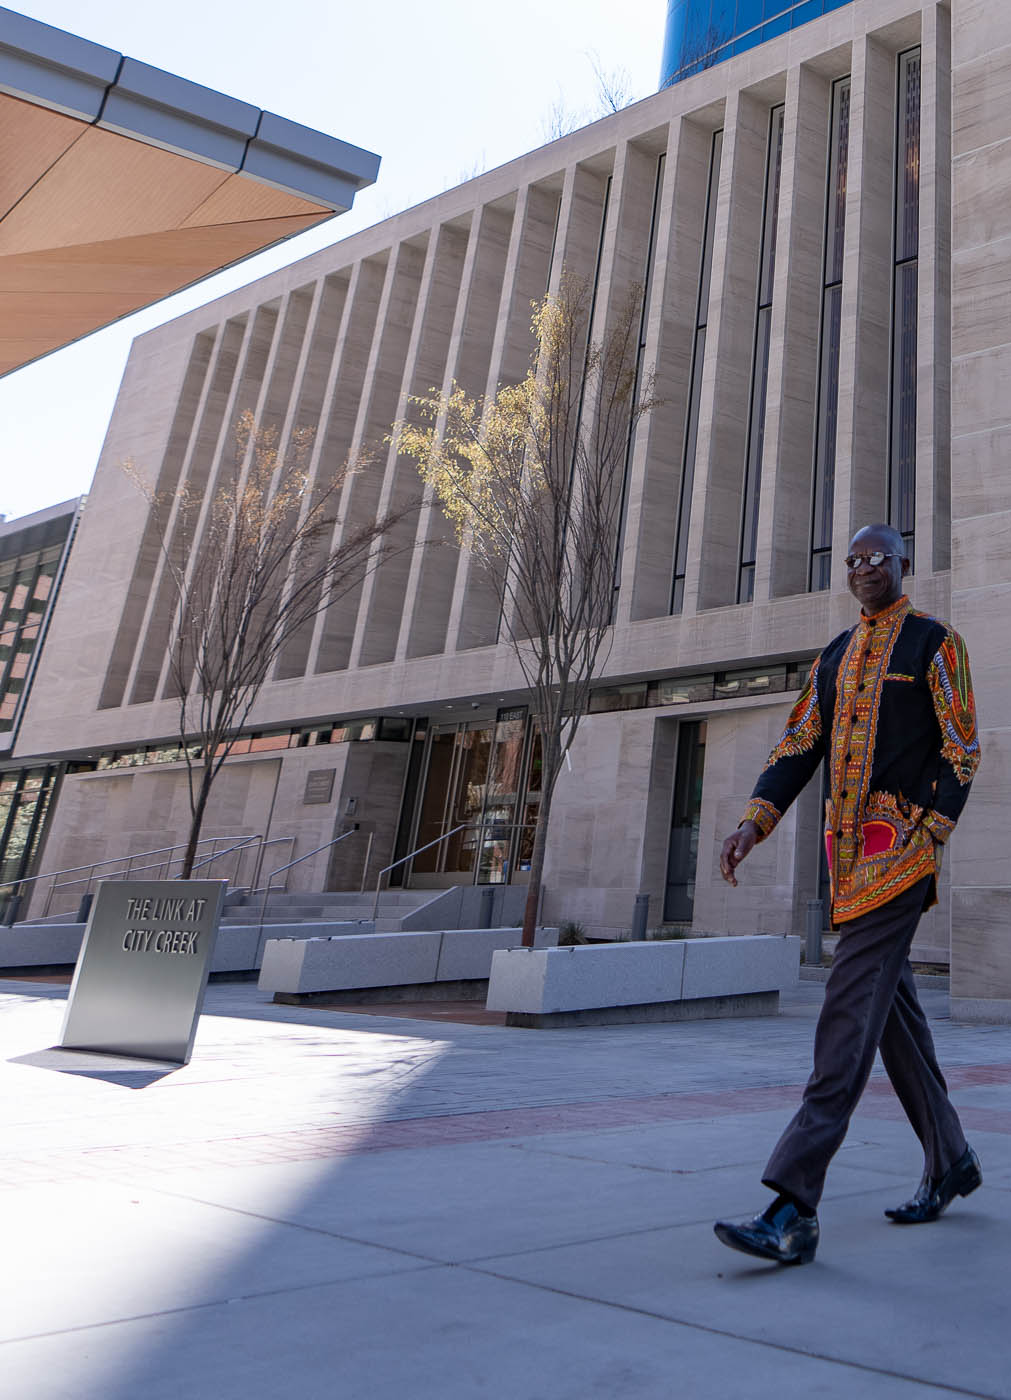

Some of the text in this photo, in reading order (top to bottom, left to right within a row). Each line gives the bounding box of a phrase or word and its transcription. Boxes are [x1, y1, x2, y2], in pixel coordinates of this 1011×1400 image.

[125, 899, 206, 922] THE LINK AT
[122, 929, 198, 954] CITY CREEK
